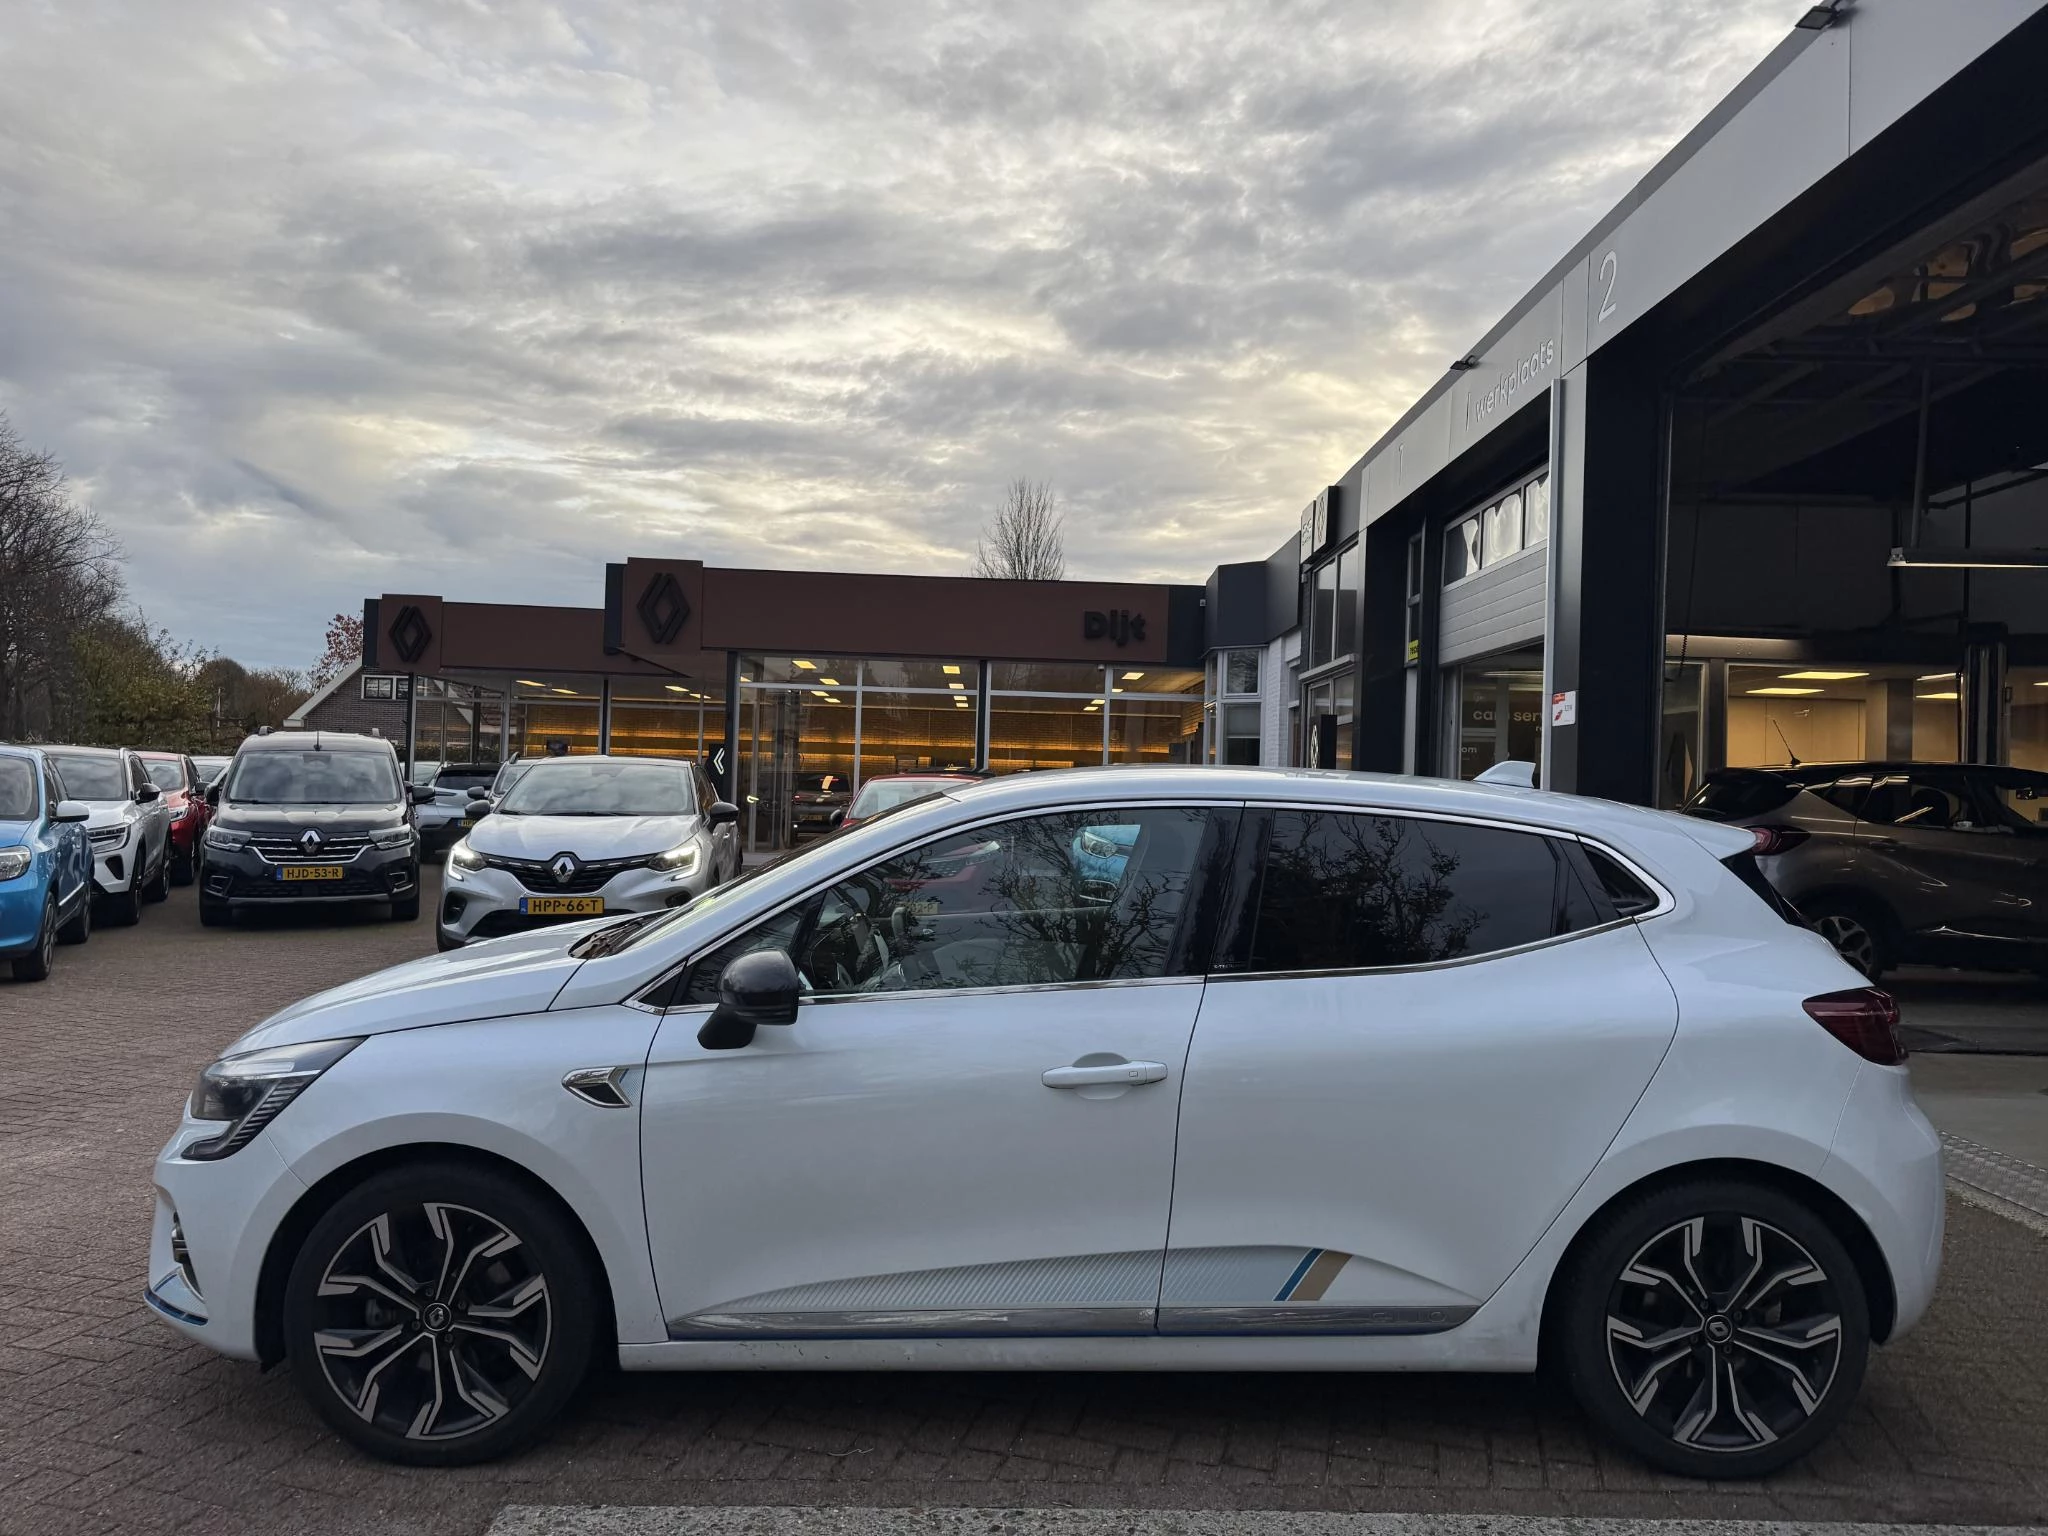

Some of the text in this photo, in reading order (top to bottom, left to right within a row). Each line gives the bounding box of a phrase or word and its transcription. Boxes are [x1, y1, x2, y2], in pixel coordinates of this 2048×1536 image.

[1598, 249, 1617, 324] 2
[1476, 339, 1554, 422] werkplaats
[1084, 609, 1146, 648] Dijt
[287, 868, 339, 879] HJD-53-R
[533, 900, 599, 912] HPP-66-T
